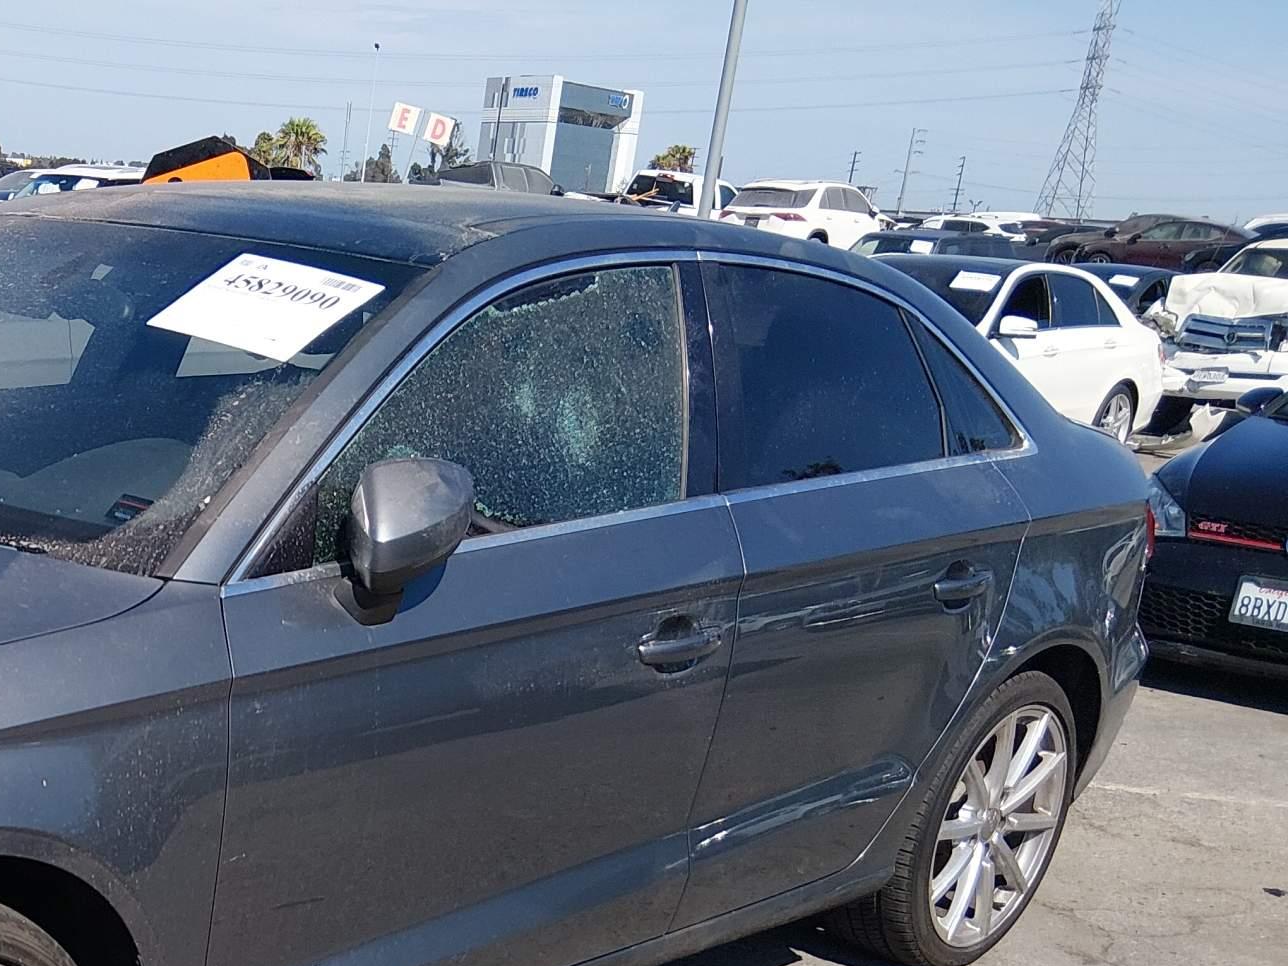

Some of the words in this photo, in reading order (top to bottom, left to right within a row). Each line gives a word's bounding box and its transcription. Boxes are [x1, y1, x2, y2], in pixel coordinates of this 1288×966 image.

[513, 88, 539, 98] TIRECO
[399, 109, 411, 128] E
[432, 120, 447, 139] D
[224, 274, 340, 309] 45829090
[1198, 522, 1228, 533] GTI
[1239, 596, 1288, 621] 8BXD
